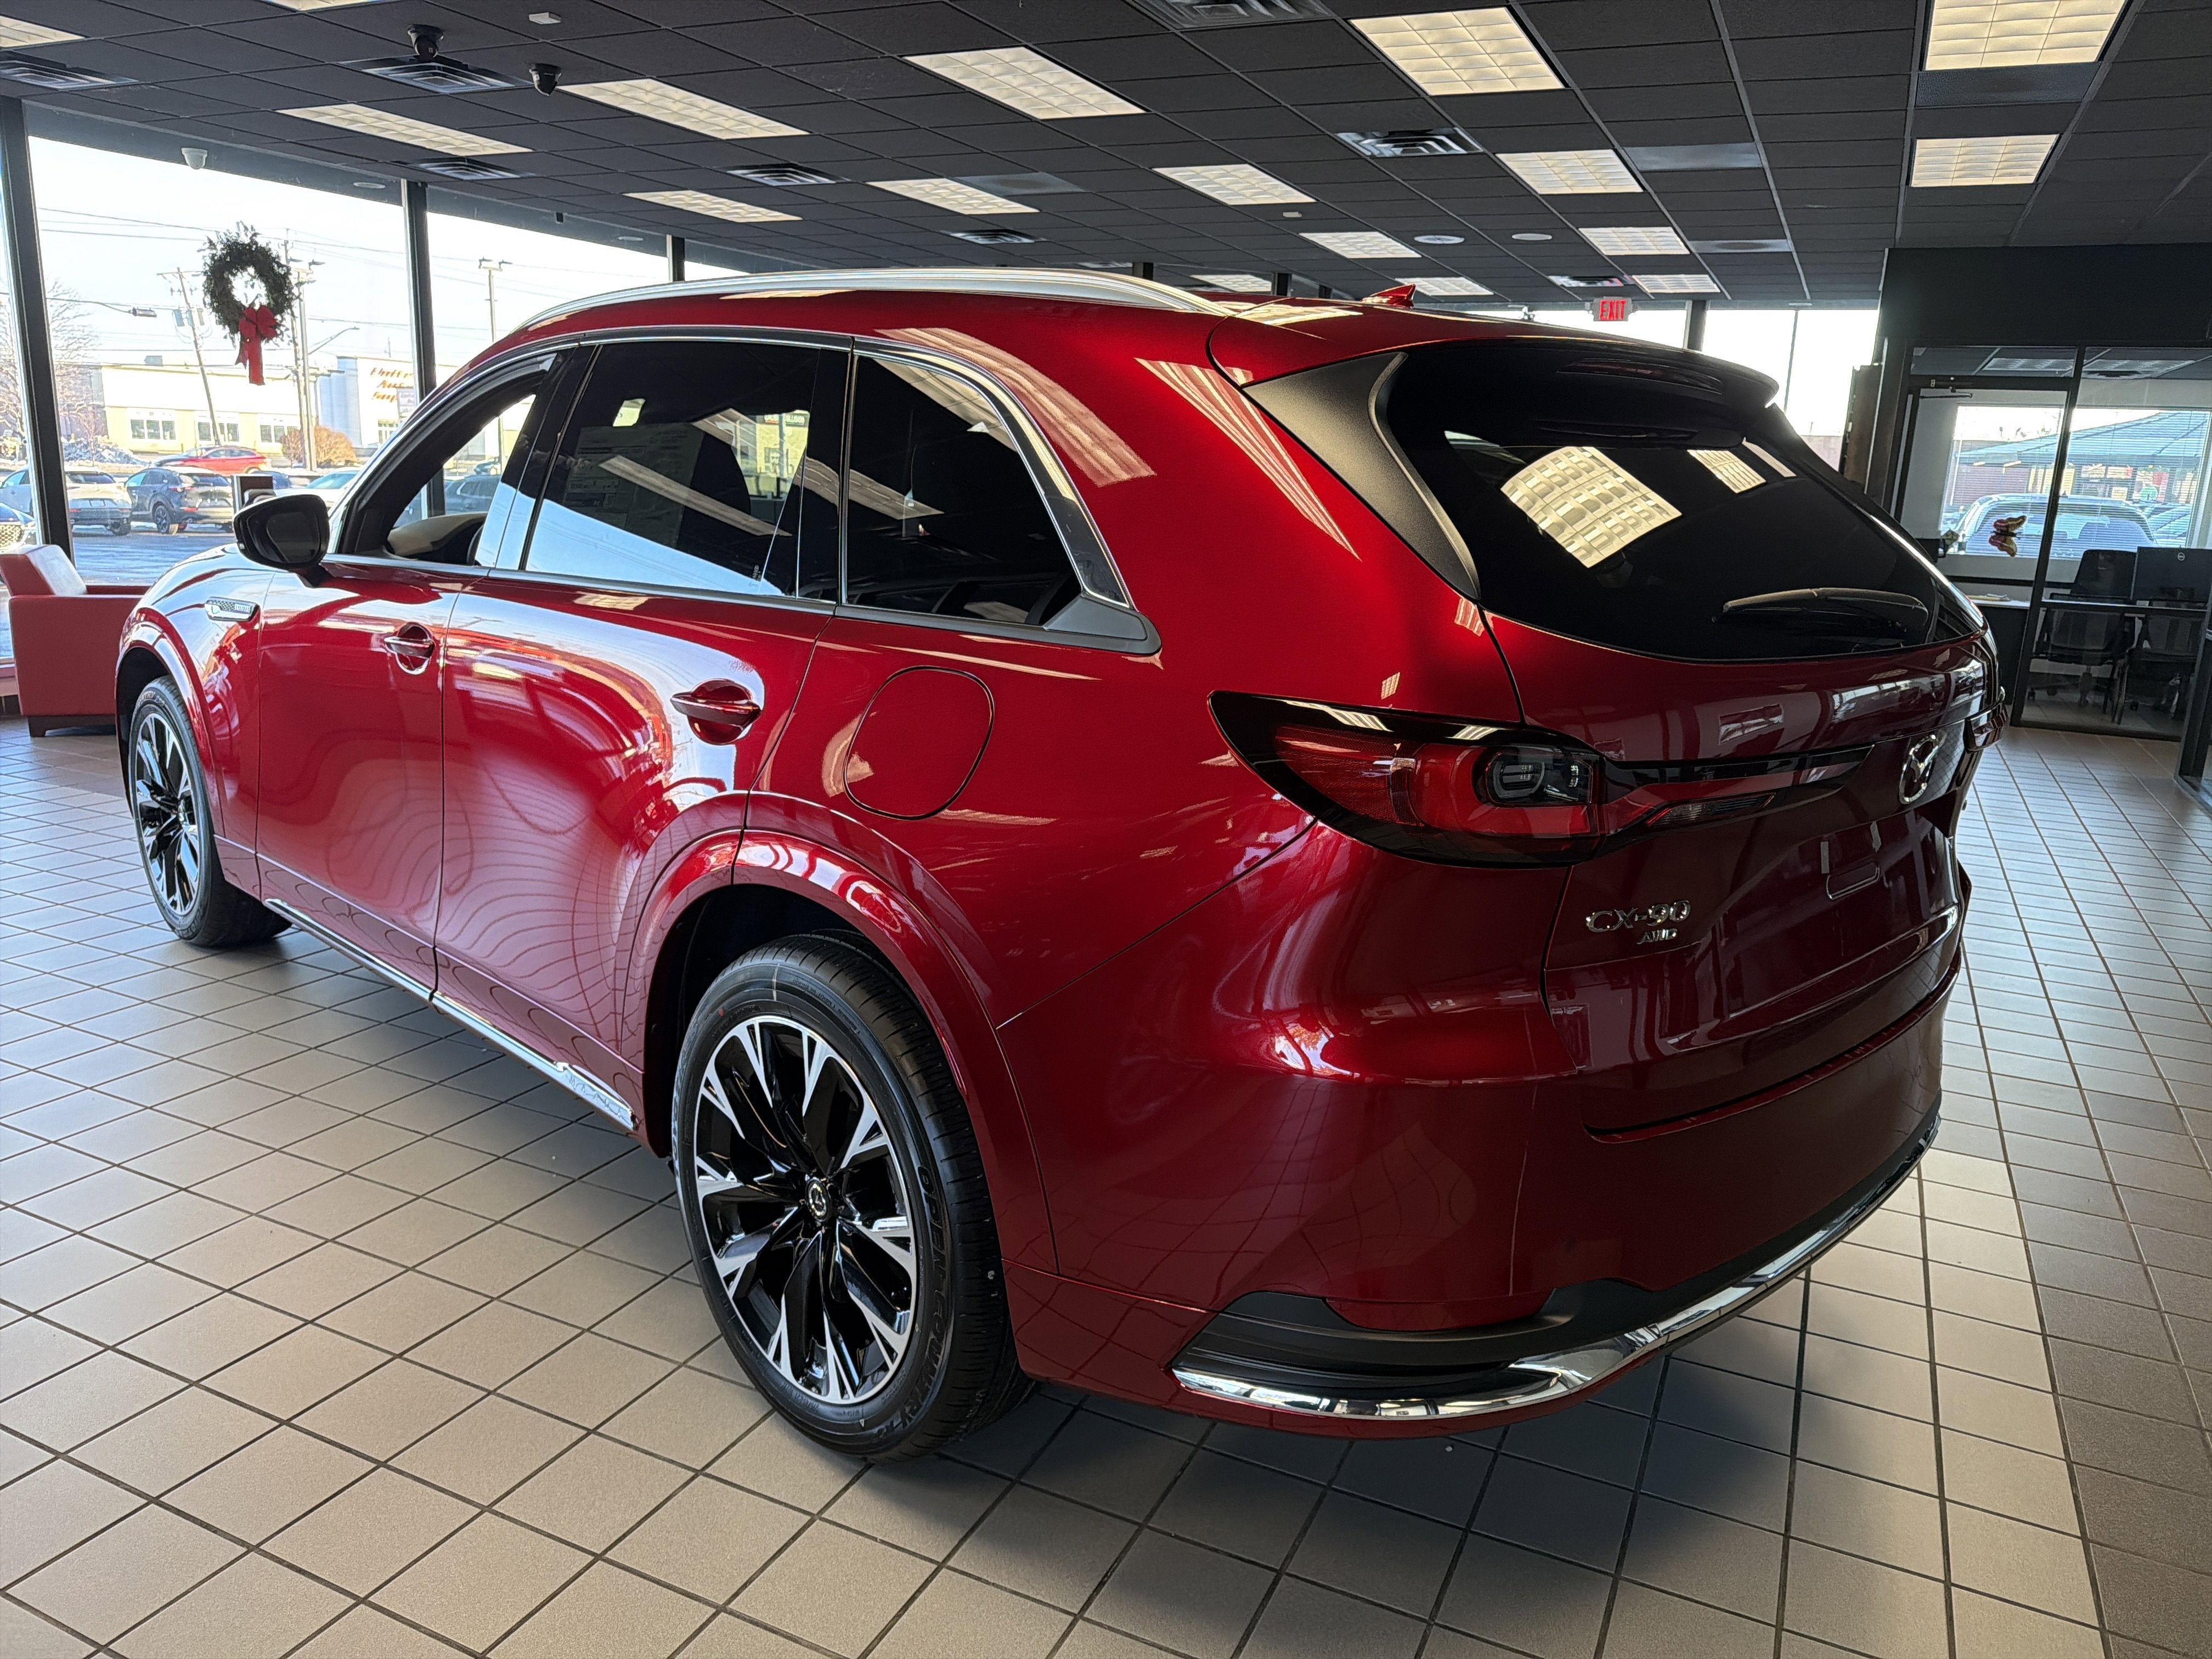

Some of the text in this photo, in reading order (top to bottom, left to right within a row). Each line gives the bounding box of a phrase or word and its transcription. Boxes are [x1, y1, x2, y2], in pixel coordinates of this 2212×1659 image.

[1599, 299, 1627, 320] EXIT
[1585, 900, 1691, 933] CX-90
[1636, 928, 1678, 945] AWD
